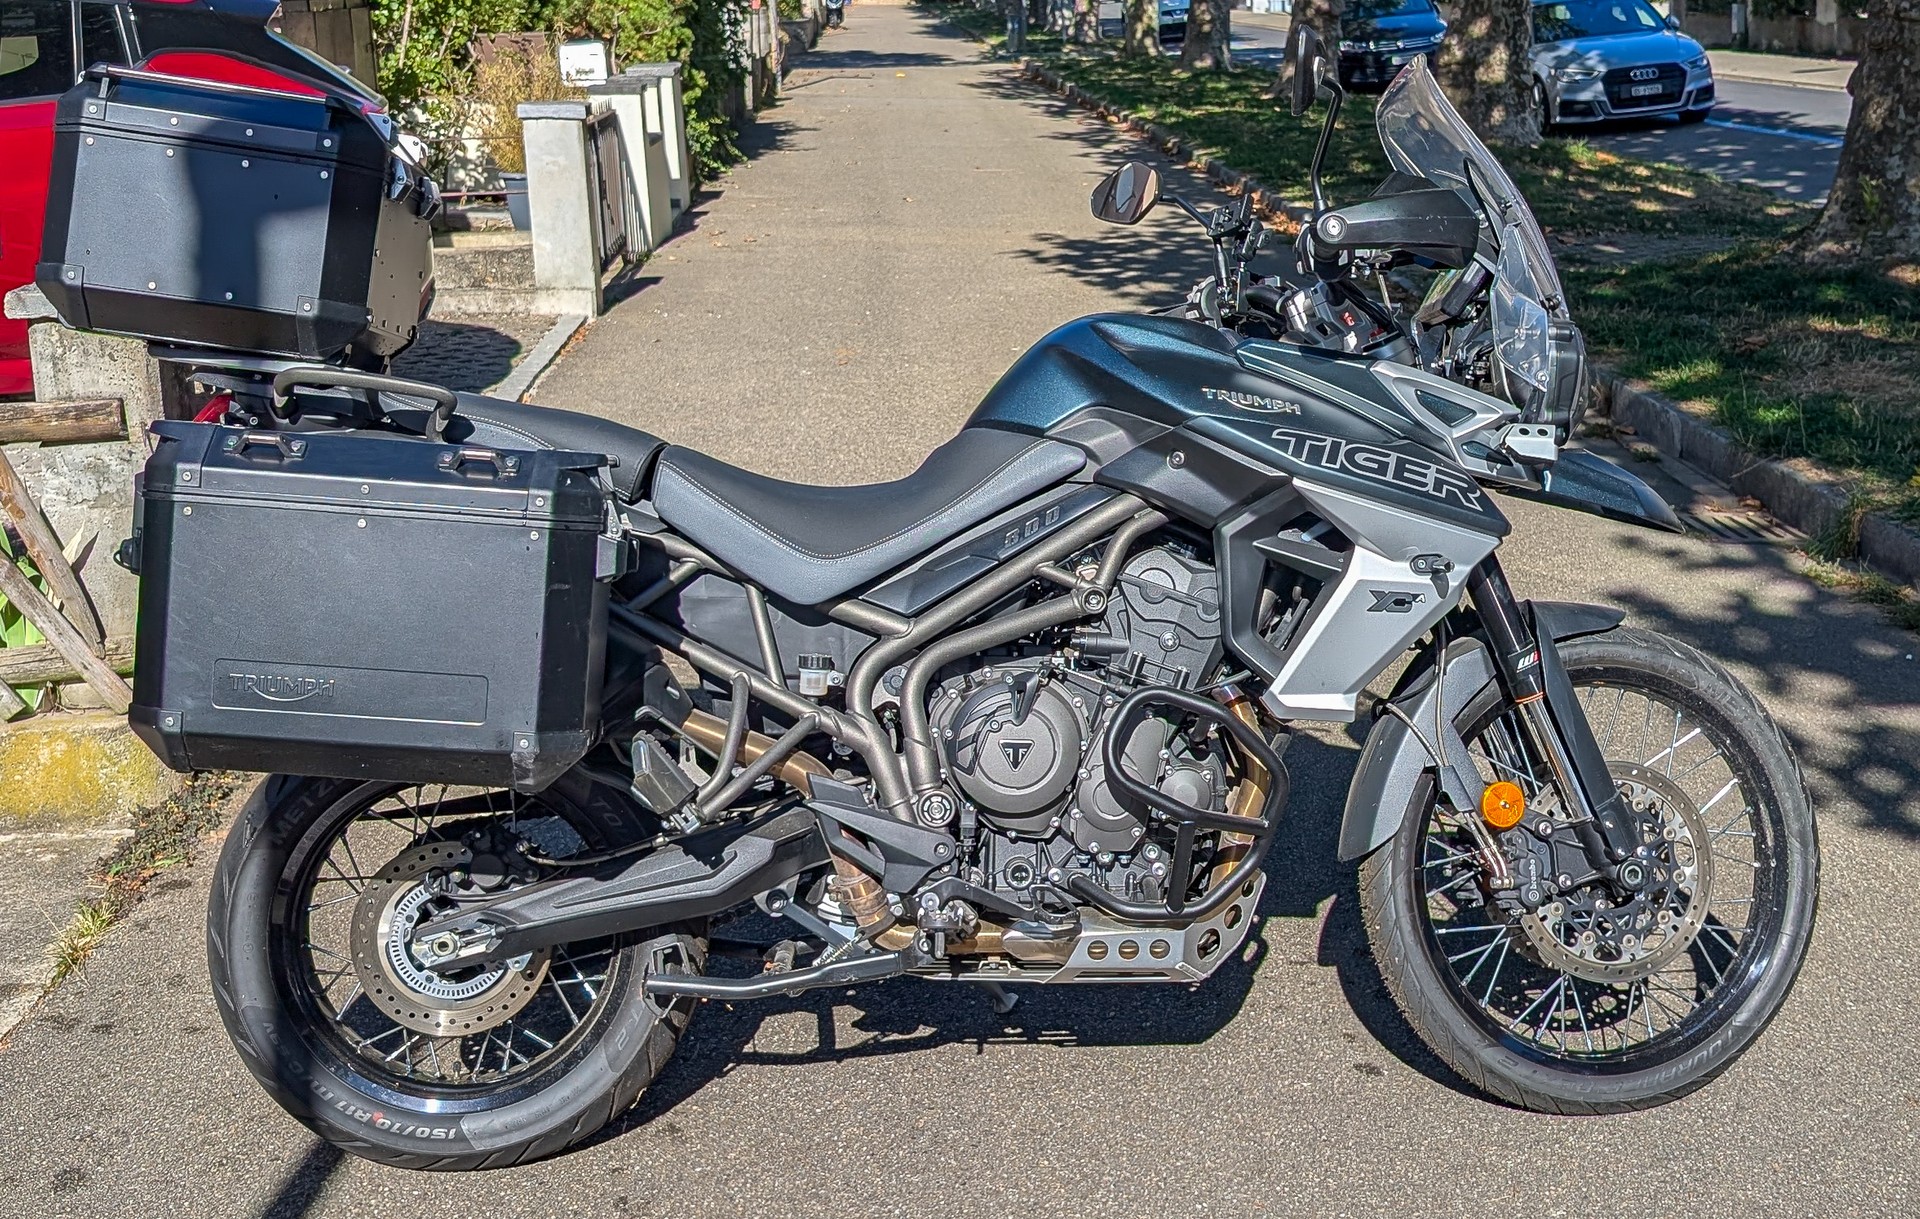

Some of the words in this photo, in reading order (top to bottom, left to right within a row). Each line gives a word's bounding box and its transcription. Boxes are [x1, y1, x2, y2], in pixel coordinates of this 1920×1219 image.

[1202, 387, 1301, 415] TRIUMPH
[1272, 428, 1483, 512] TIGER
[229, 673, 335, 702] TRIUMPH
[1528, 859, 1538, 889] brembo
[334, 1099, 372, 1123] R17
[375, 1117, 457, 1140] 150/70
